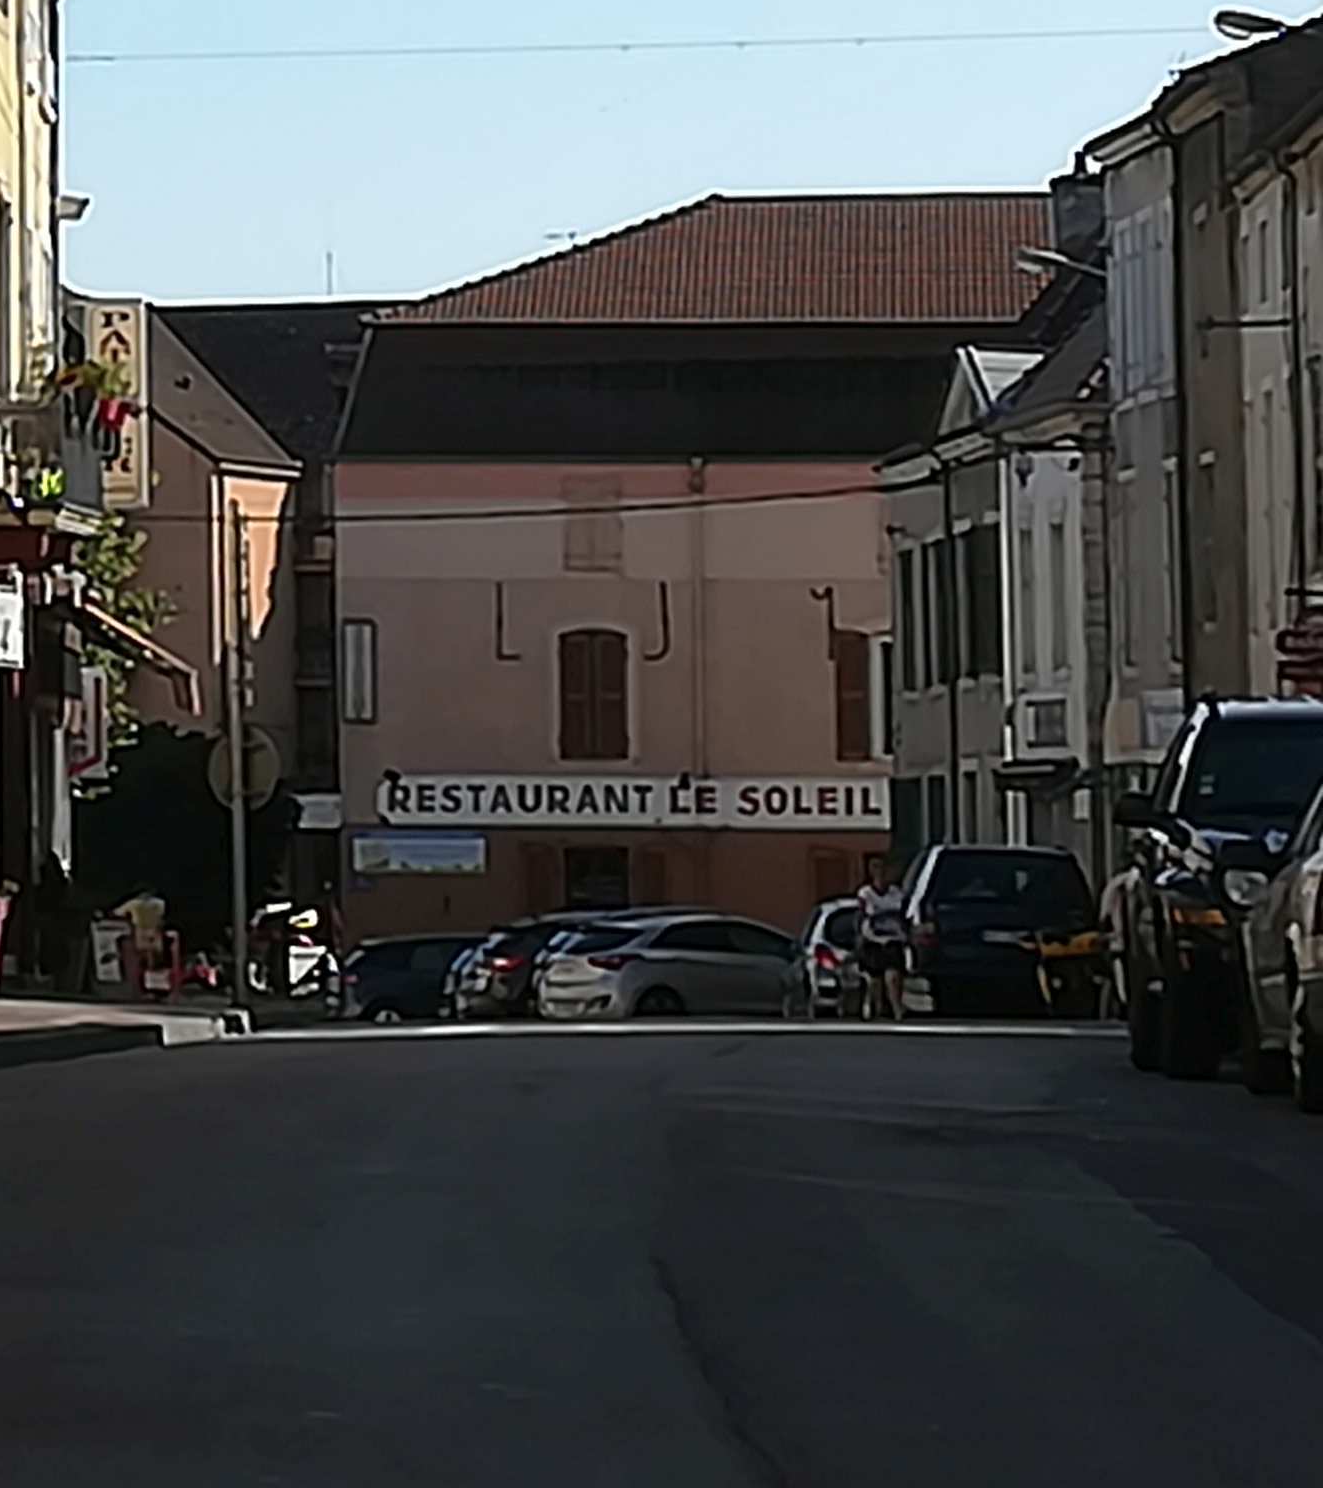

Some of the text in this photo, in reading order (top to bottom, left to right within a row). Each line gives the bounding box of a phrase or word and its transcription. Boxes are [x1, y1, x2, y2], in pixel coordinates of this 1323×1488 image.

[388, 782, 882, 816] RESTAURANT LE SOLEIL
